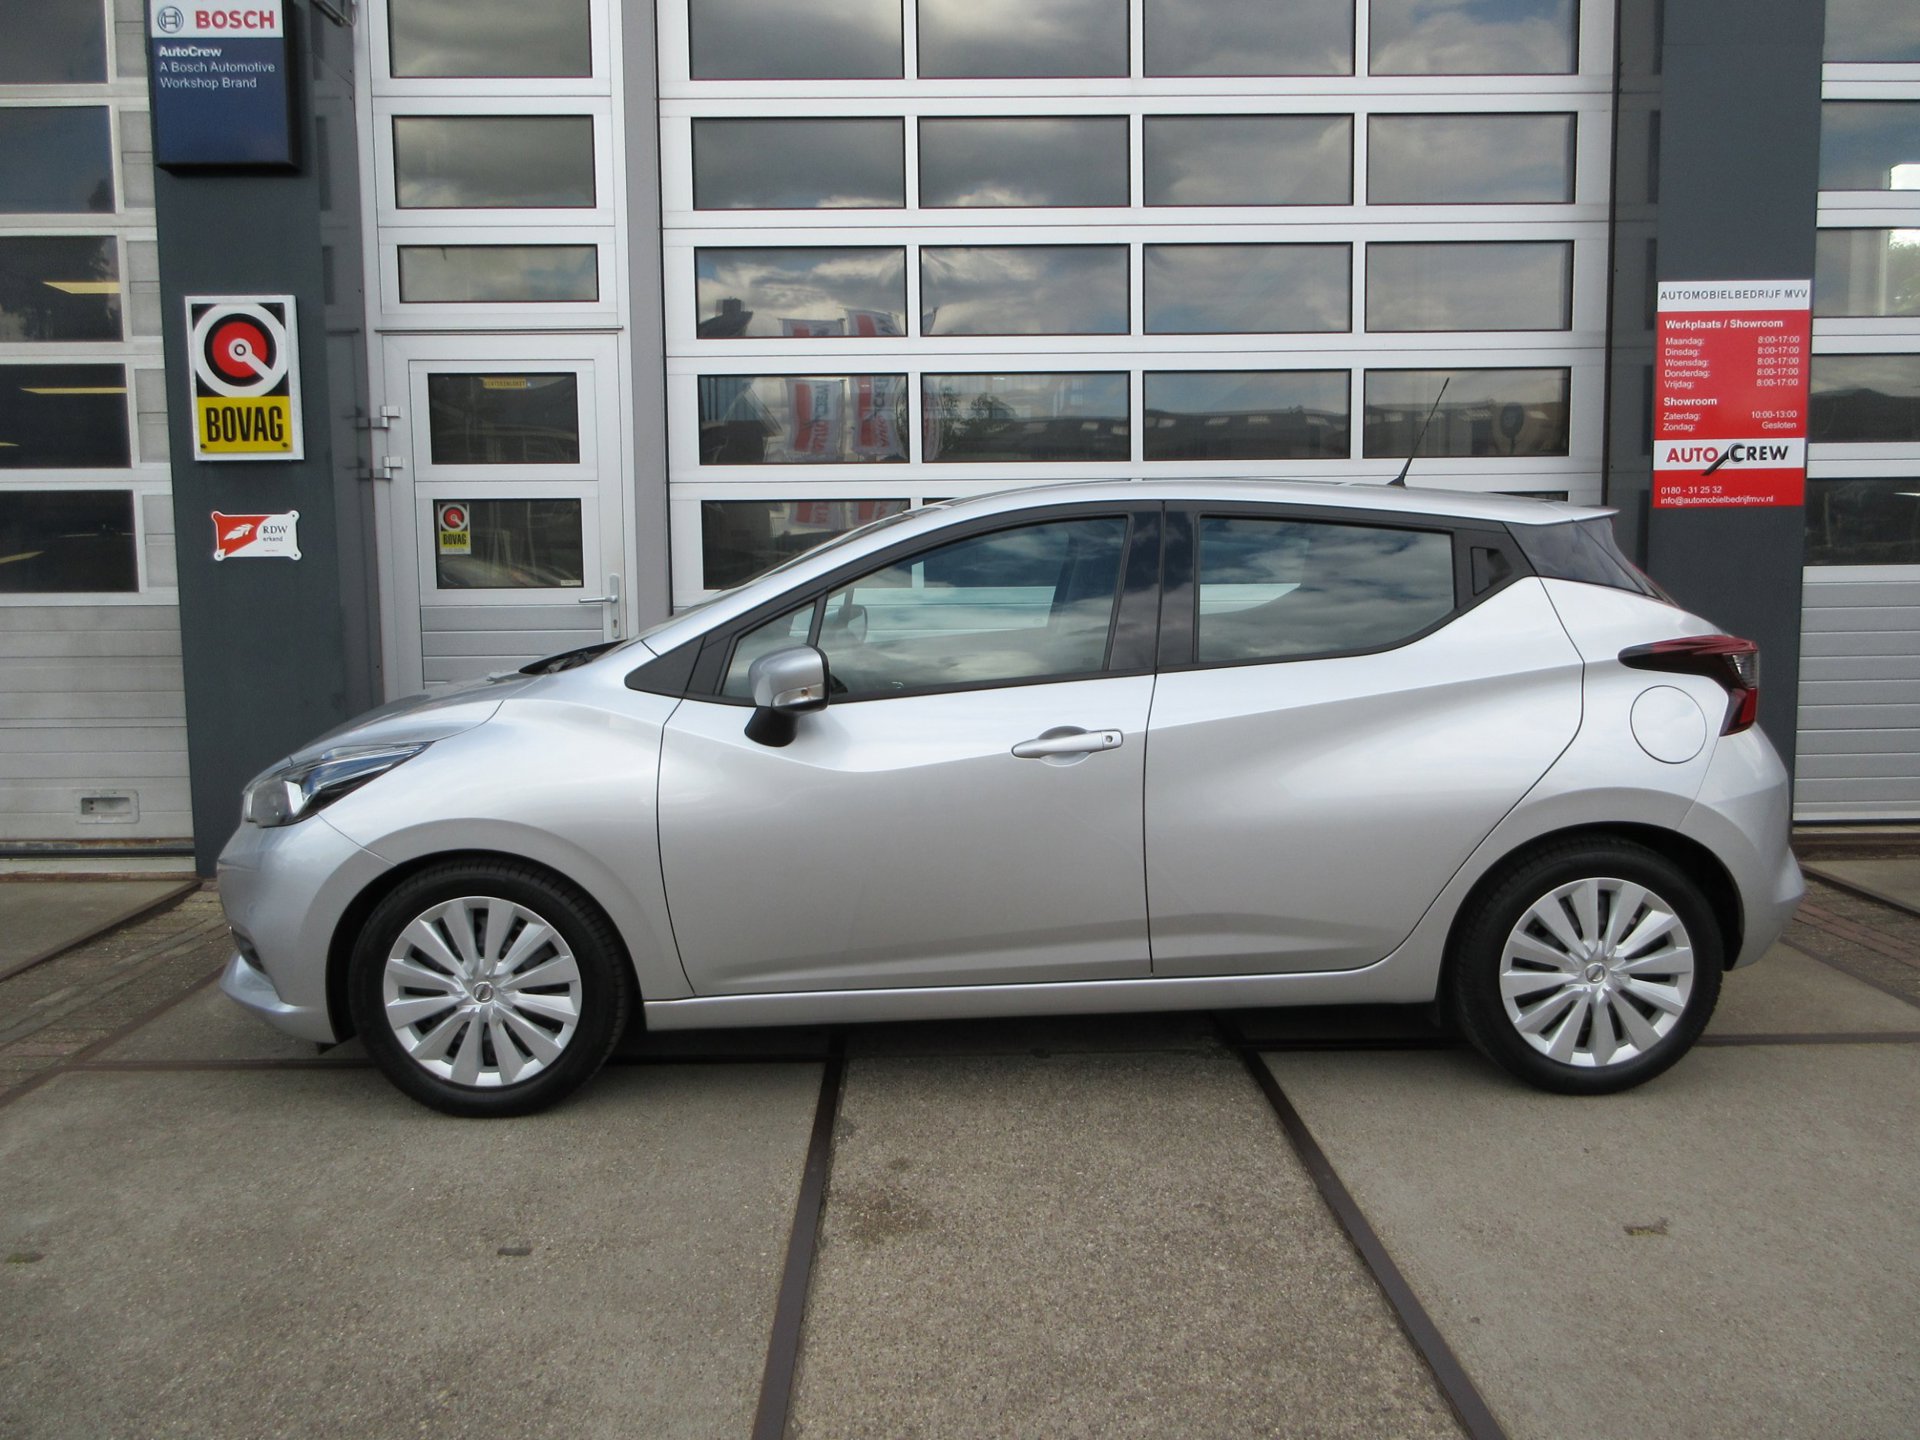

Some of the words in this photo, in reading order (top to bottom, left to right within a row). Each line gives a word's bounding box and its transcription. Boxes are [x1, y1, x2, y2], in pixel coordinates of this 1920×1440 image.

[195, 10, 275, 29] BOSCH
[159, 46, 222, 57] AutoCrew
[160, 62, 168, 72] A
[171, 62, 207, 73] Bosch
[210, 62, 275, 73] Automotive
[160, 77, 219, 90] Workshop
[222, 77, 257, 88] Brand
[1660, 289, 1781, 300] AUTOMOBIELBEDRIJF
[1784, 289, 1808, 299] MVV
[1665, 320, 1721, 331] Werkplaats
[1729, 319, 1784, 329] Showroom
[1665, 337, 1704, 346] Maandag:
[1665, 348, 1700, 358] Dinsdag:
[1665, 359, 1709, 368] Woensdag:
[1664, 370, 1710, 379] Donderdag:
[1664, 380, 1694, 390] Vrijdag:
[1663, 397, 1718, 407] Showroom
[1663, 412, 1701, 421] Zaterdag:
[206, 406, 283, 442] BOVAG
[1663, 423, 1695, 432] Zondag:
[1761, 421, 1797, 430] Gesloten
[1666, 447, 1718, 463] AUTO
[1730, 443, 1789, 463] CREW
[1660, 486, 1681, 495] 0180
[1688, 486, 1698, 494] 31
[1700, 486, 1711, 494] 25
[1711, 486, 1722, 494] 32
[263, 525, 288, 534] RDW
[443, 533, 467, 545] BOVAG
